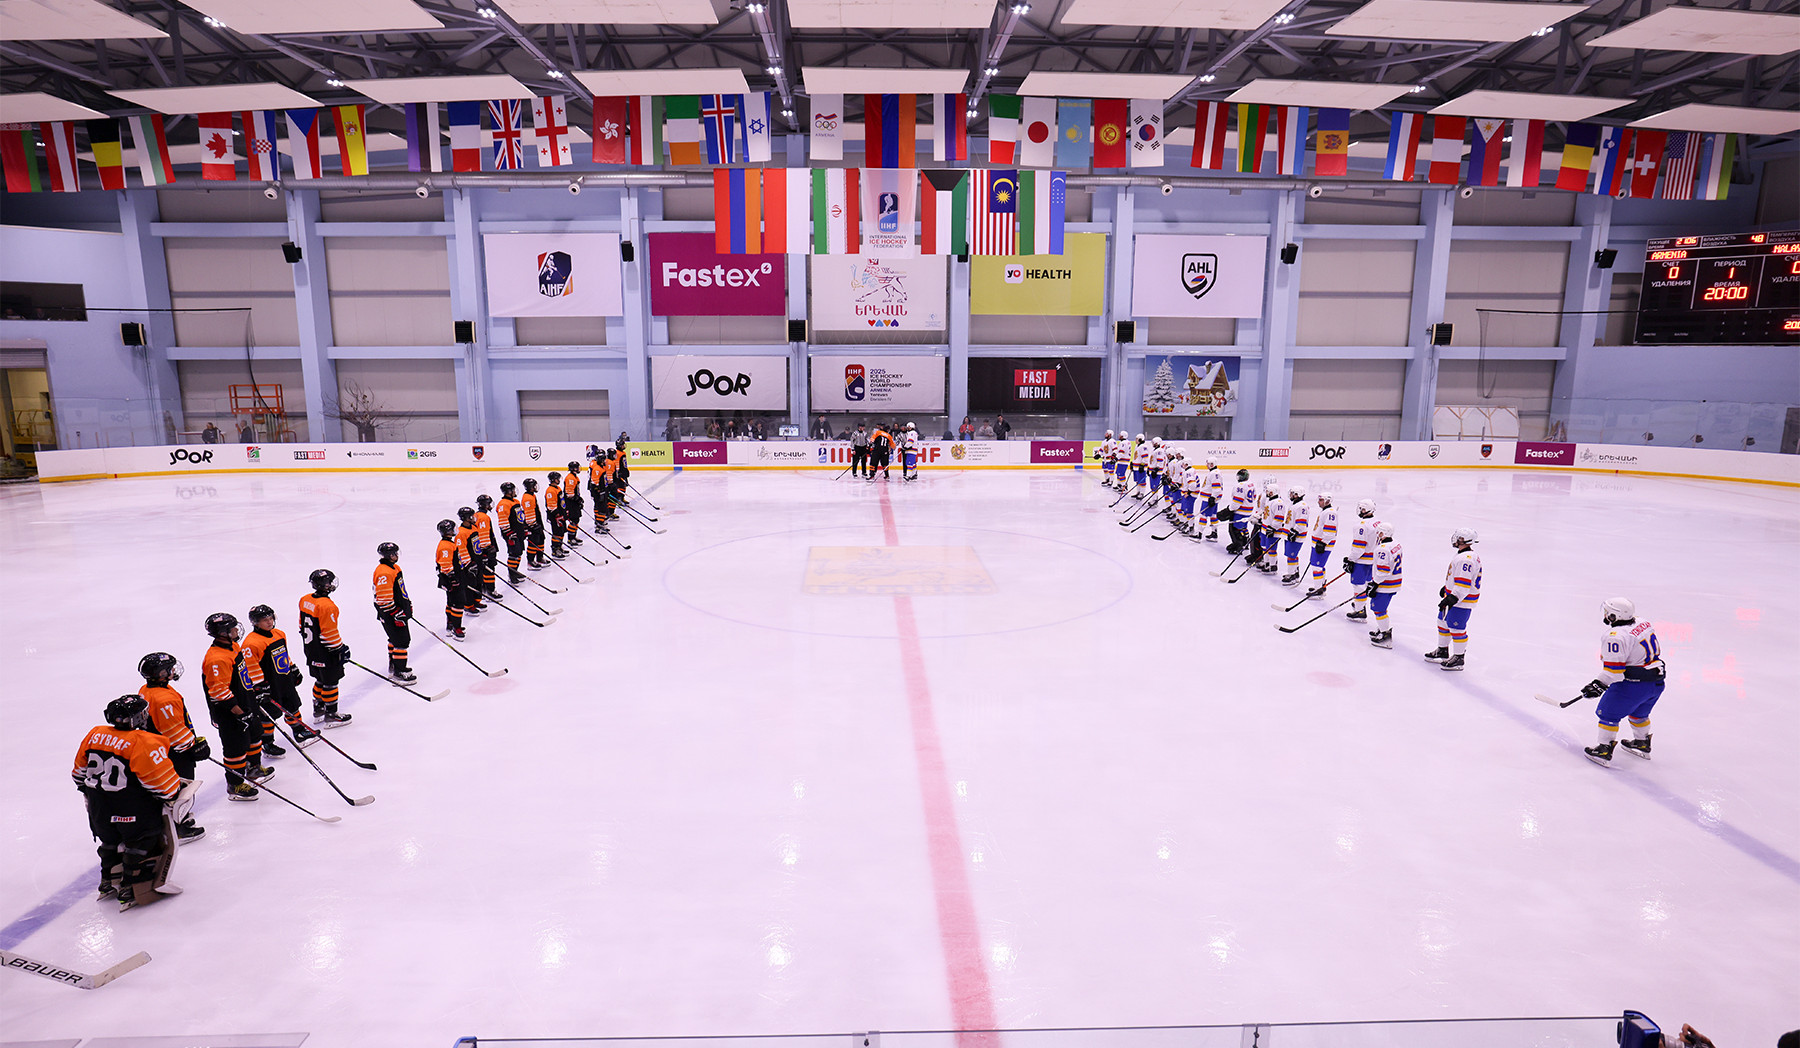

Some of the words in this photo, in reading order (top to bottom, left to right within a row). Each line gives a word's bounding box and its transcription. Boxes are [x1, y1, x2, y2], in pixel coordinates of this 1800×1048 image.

[880, 222, 897, 230] IIHF
[1751, 234, 1764, 243] 48
[1651, 250, 1688, 260] ARMENIA
[1187, 262, 1212, 273] AHL
[1713, 259, 1747, 267] ПЕРИОД
[662, 262, 761, 288] Fastex
[1026, 269, 1071, 279] HEALTH
[1669, 266, 1680, 279] 0
[1729, 266, 1735, 278] 1
[540, 283, 565, 297] AIHF
[1651, 280, 1691, 288] УДАЛЕНИЯ
[1704, 286, 1748, 300] 20:00
[686, 369, 752, 397] JOOR
[1023, 371, 1048, 383] FAST
[1019, 386, 1051, 399] MEDIA
[169, 449, 213, 465] JOOR
[683, 449, 714, 458] Fastex
[1040, 448, 1071, 457] Fastex
[1309, 444, 1346, 460] JOOR
[1525, 449, 1559, 459] Fastex
[1607, 642, 1619, 653] 10
[212, 664, 219, 677] 5
[160, 704, 175, 720] 17
[149, 745, 168, 765] 20
[84, 752, 128, 792] 20
